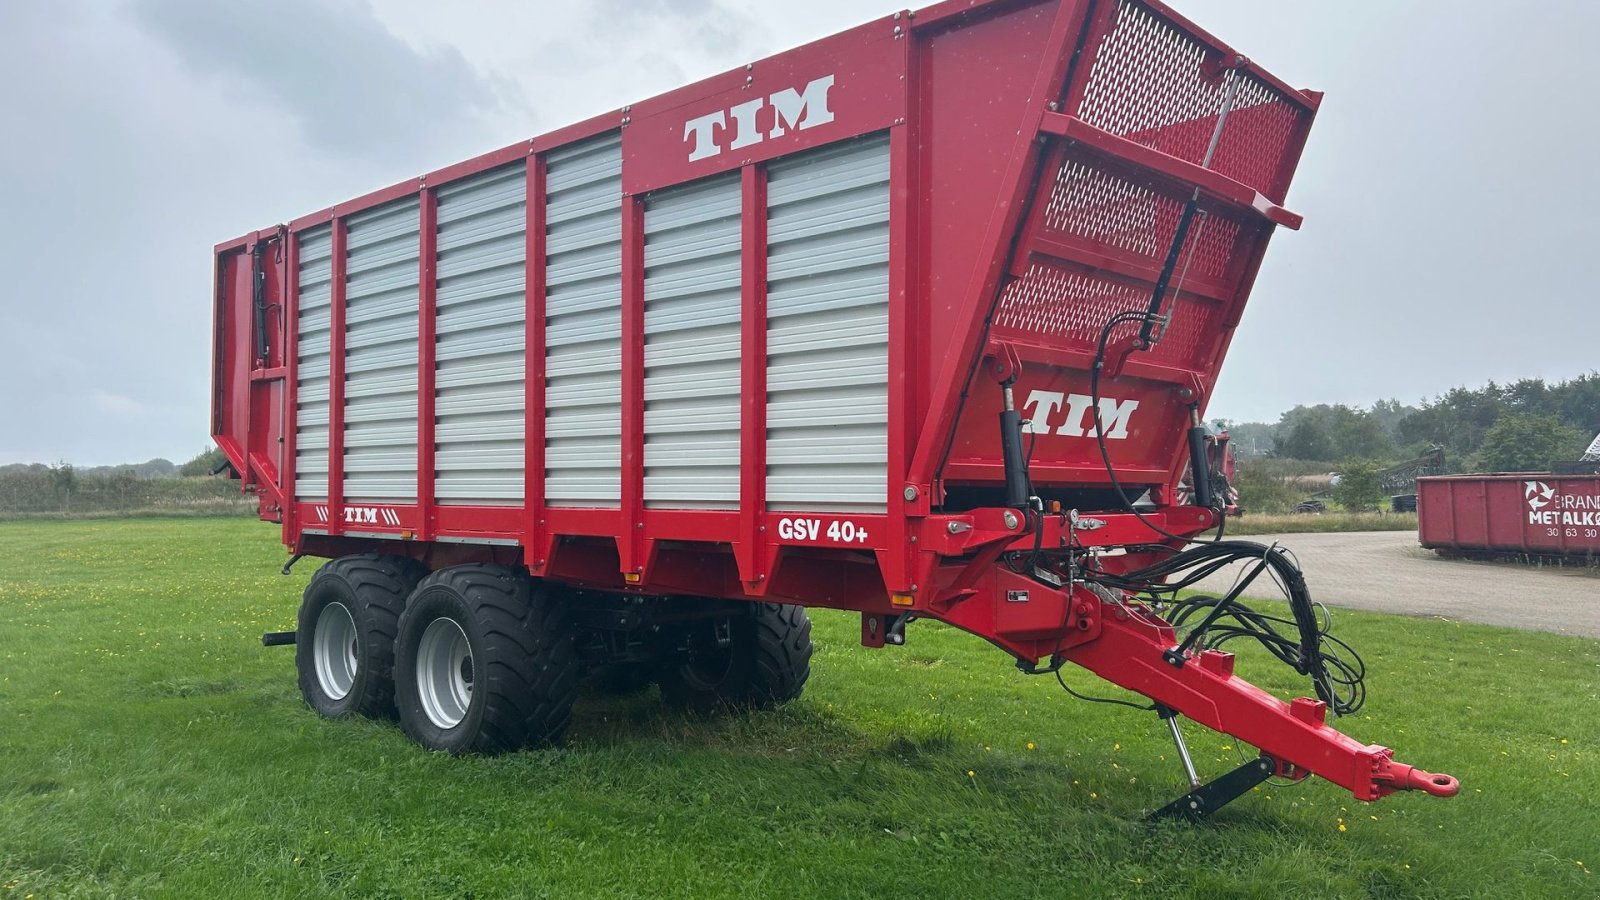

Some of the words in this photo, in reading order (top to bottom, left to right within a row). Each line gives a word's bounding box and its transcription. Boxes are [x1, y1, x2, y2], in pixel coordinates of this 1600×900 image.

[683, 74, 834, 162] TIM
[1021, 389, 1139, 439] TIM
[344, 507, 378, 523] TIM
[778, 517, 821, 541] GSV
[826, 520, 868, 543] 40+
[1546, 527, 1559, 537] 30
[1565, 527, 1578, 537] 63
[1584, 528, 1597, 538] 30
